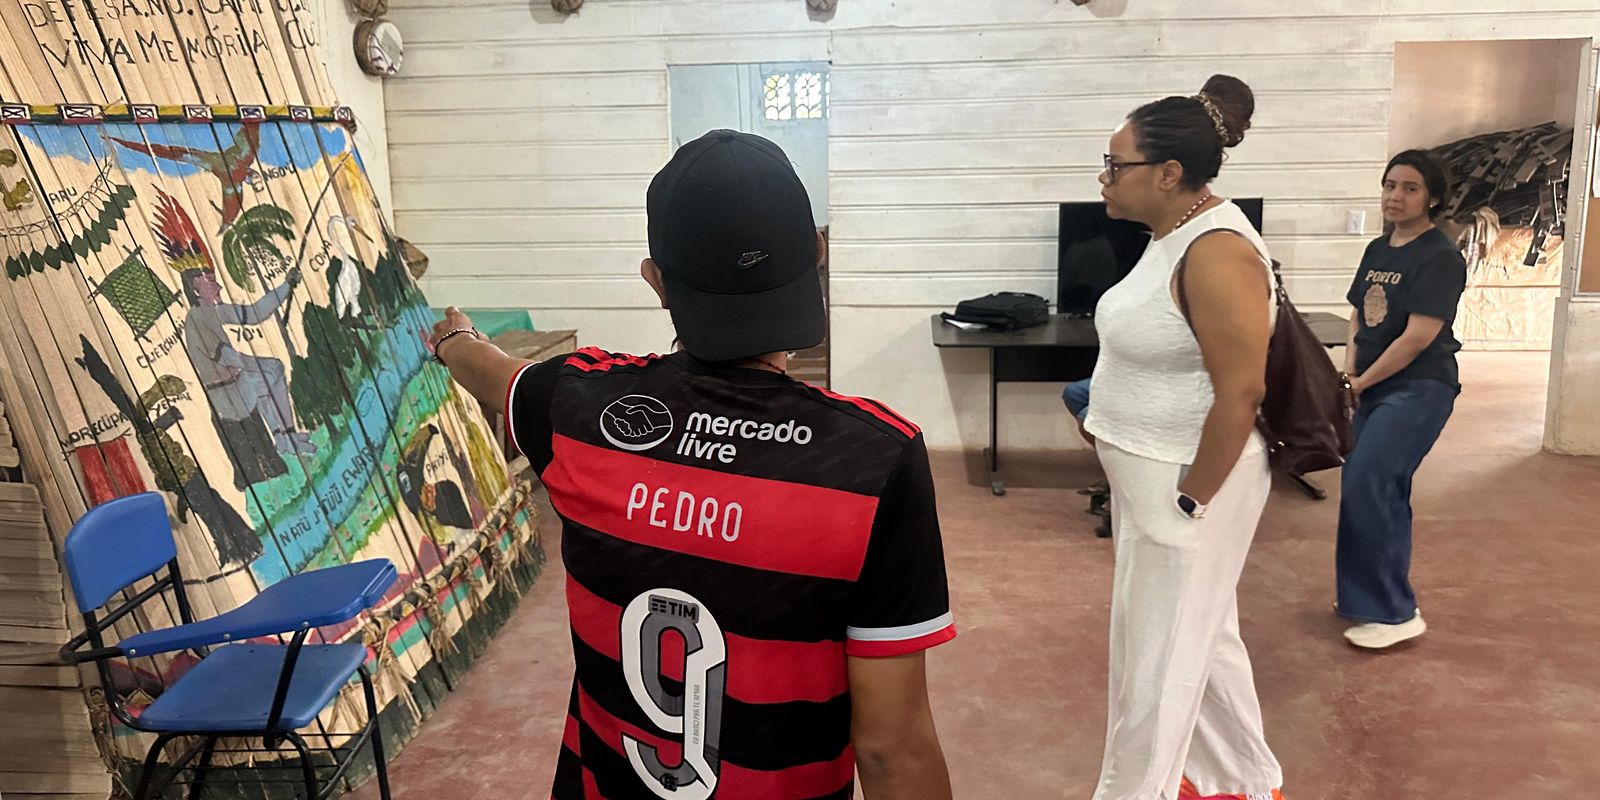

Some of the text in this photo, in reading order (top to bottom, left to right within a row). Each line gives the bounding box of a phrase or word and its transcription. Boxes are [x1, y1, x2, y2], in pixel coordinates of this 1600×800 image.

[49, 186, 77, 204] ARU
[1365, 270, 1402, 284] PORTO
[686, 412, 812, 445] mercado
[677, 433, 737, 463] livre
[627, 482, 742, 542] PEDRO
[669, 602, 697, 620] TIM
[621, 588, 726, 800] 9
